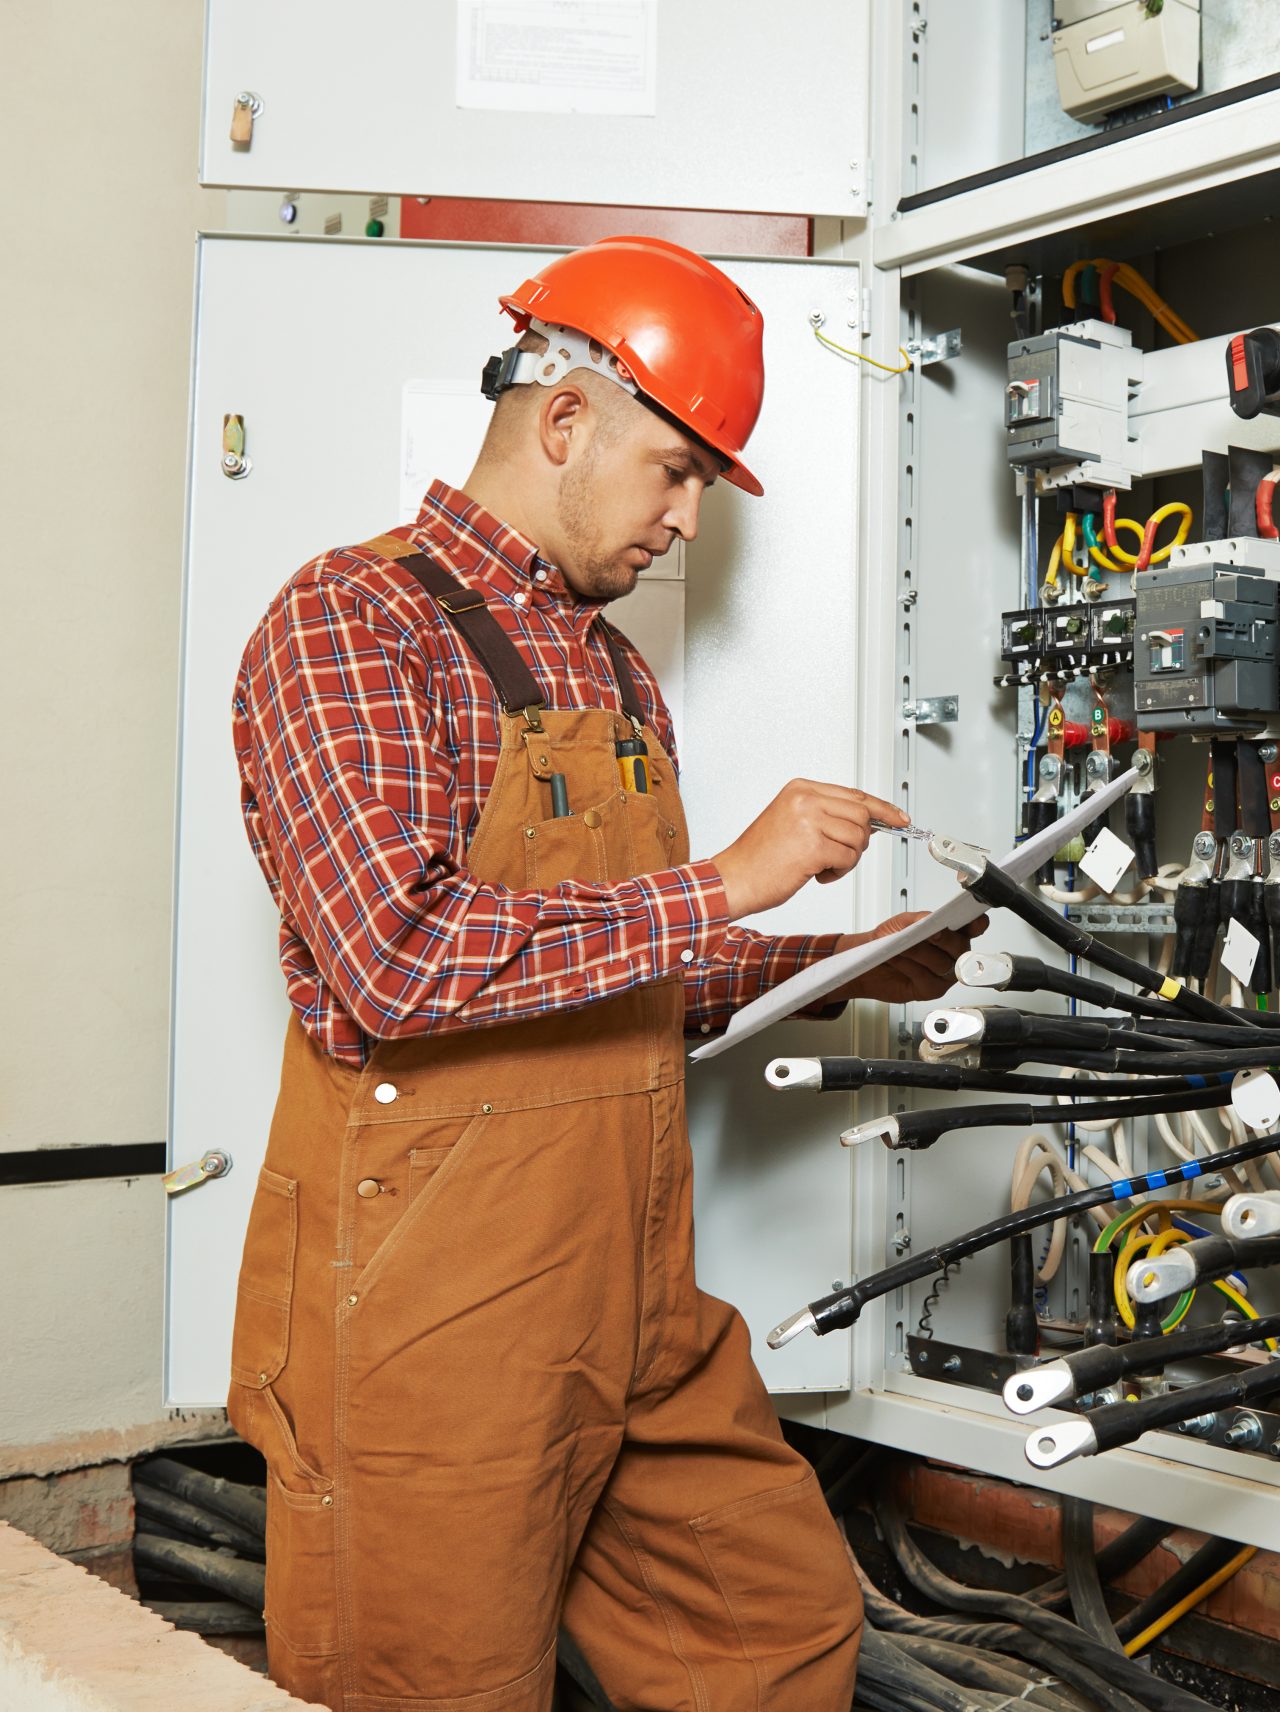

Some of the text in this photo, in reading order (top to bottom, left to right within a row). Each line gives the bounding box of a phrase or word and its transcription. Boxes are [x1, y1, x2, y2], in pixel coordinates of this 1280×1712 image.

[1052, 712, 1060, 722] A
[1094, 709, 1102, 721] B
[1273, 776, 1280, 787] C
